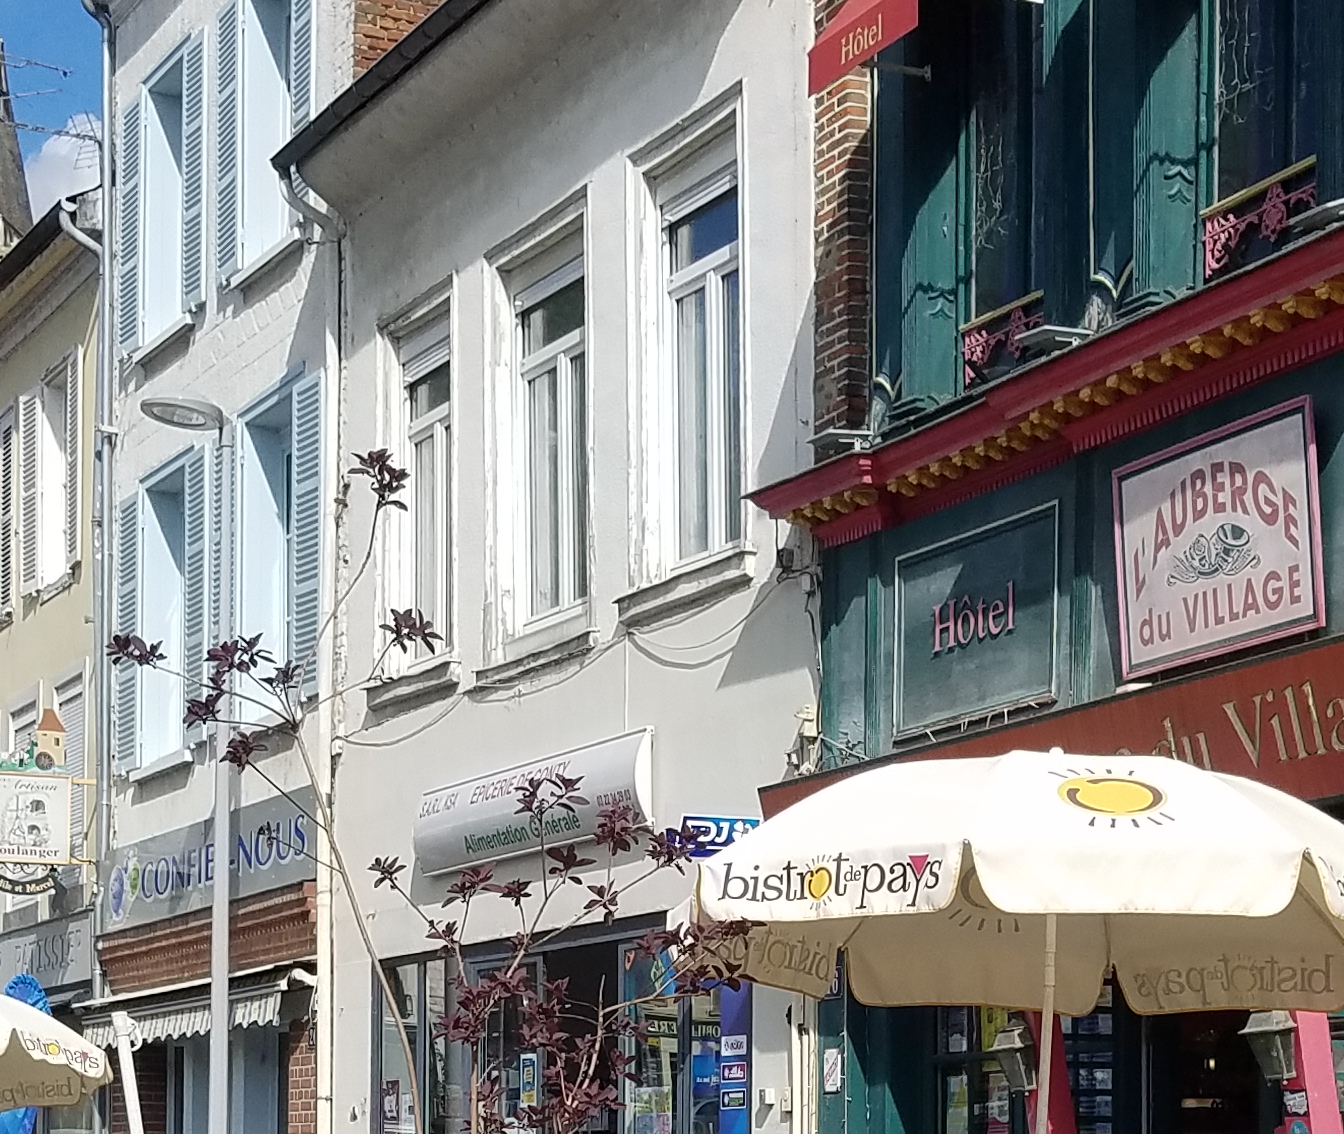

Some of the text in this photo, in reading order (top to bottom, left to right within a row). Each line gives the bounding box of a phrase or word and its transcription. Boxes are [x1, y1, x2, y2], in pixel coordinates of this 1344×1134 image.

[840, 13, 882, 65] Hôtel
[1133, 461, 1300, 602] L'AUBERGE
[930, 582, 1017, 653] Hôtel
[1139, 563, 1302, 647] du VILLAGE
[464, 824, 530, 854] Alimentation
[717, 852, 849, 902] bistrot
[856, 857, 943, 910] pays
